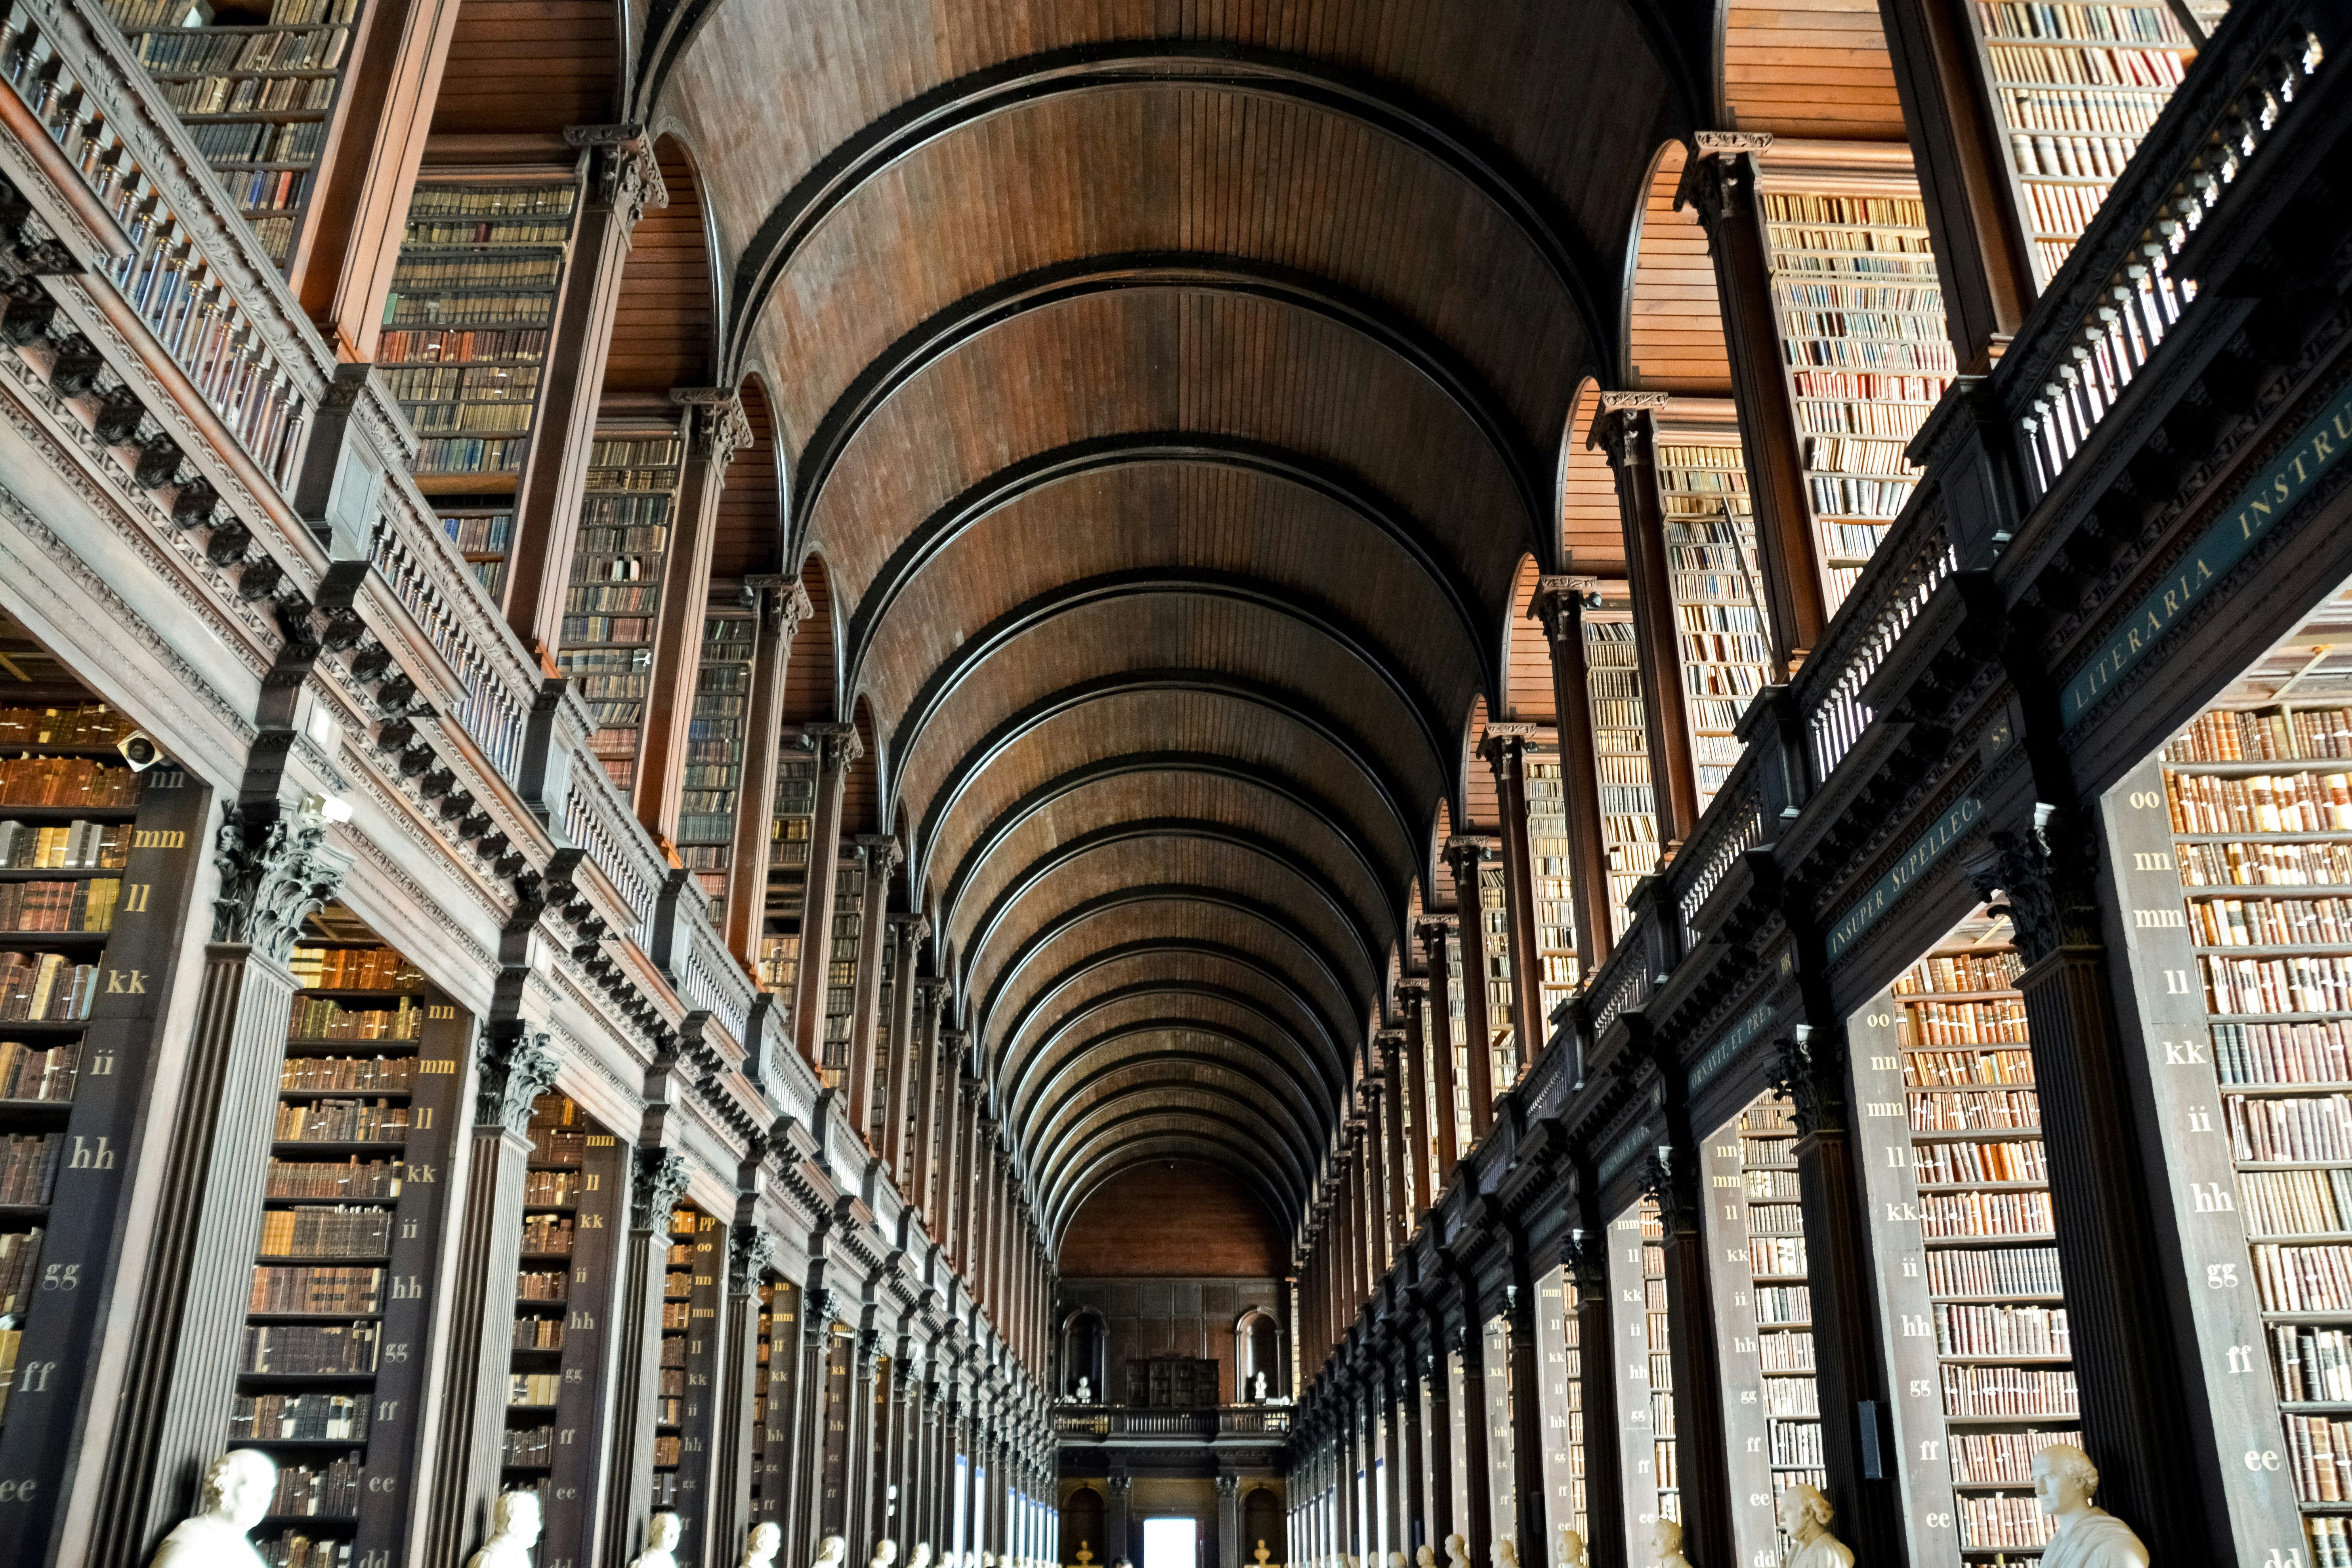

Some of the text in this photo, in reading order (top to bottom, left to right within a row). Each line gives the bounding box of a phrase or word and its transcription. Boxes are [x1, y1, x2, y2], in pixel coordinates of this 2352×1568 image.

[2075, 401, 2352, 710] LITERARIA INSTRU
[1992, 716, 2010, 750] SS
[149, 769, 184, 788] nn
[2130, 792, 2159, 809] oo
[134, 830, 185, 848] mm
[2133, 853, 2173, 870] nn
[124, 884, 149, 912] ll
[1833, 890, 1884, 954] INSUPER
[2133, 909, 2185, 927] mm
[1780, 952, 1791, 975] RR
[105, 970, 150, 994] kk
[2164, 970, 2190, 994] ll
[429, 1005, 454, 1019] nn
[1867, 1014, 1889, 1027] oo
[1731, 1028, 1742, 1051] ET
[2163, 1041, 2207, 1064] kk
[90, 1049, 114, 1074] ii
[419, 1060, 455, 1074] mm
[1871, 1056, 1898, 1070] nn
[1867, 1103, 1905, 1117] mm
[415, 1108, 433, 1129] ll
[2188, 1106, 2213, 1132] ii
[586, 1135, 615, 1146] mm
[68, 1136, 114, 1169] hh
[1717, 1146, 1737, 1157] nn
[1886, 1147, 1905, 1167] ll
[407, 1165, 437, 1183] kk
[586, 1174, 599, 1190] ll
[1713, 1176, 1741, 1187] mm
[2190, 1183, 2235, 1213] hh
[1725, 1205, 1737, 1220] ll
[1886, 1203, 1918, 1221] kk
[581, 1214, 603, 1228] kk
[700, 1217, 715, 1231] pp
[1617, 1219, 1640, 1230] mm
[402, 1219, 417, 1238] ii
[697, 1244, 711, 1252] oo
[1628, 1249, 1639, 1263] ll
[1727, 1249, 1748, 1262] kk
[1902, 1257, 1919, 1278] ii
[42, 1263, 80, 1291] gg
[576, 1268, 586, 1283] ii
[695, 1276, 711, 1285] nn
[2207, 1263, 2238, 1289] gg
[391, 1276, 421, 1299] hh
[1623, 1289, 1642, 1301] kk
[1735, 1292, 1746, 1306] ii
[570, 1312, 594, 1329] hh
[693, 1309, 714, 1318] mm
[1551, 1320, 1560, 1330] ll
[1630, 1323, 1641, 1336] ii
[1901, 1314, 1932, 1336] hh
[691, 1341, 701, 1354] ll
[774, 1341, 783, 1352] ll
[1494, 1339, 1501, 1349] ll
[1734, 1337, 1756, 1353] hh
[385, 1344, 408, 1363] gg
[1549, 1353, 1565, 1362] kk
[2226, 1345, 2253, 1373] ff
[19, 1361, 57, 1392] ff
[565, 1369, 582, 1383] gg
[772, 1371, 788, 1381] kk
[832, 1366, 846, 1375] kk
[1491, 1368, 1504, 1376] kk
[1630, 1365, 1648, 1379] hh
[689, 1374, 706, 1385] kk
[1910, 1379, 1931, 1397] gg
[769, 1399, 778, 1410] ii
[832, 1393, 839, 1402] ii
[1496, 1397, 1502, 1406] ii
[1741, 1391, 1757, 1404] gg
[378, 1401, 397, 1421] ff
[688, 1405, 697, 1416] ii
[1631, 1411, 1645, 1422] gg
[830, 1421, 843, 1431] hh
[1550, 1416, 1565, 1428] hh
[560, 1429, 575, 1445] ff
[768, 1429, 783, 1441] hh
[1495, 1427, 1508, 1437] hh
[684, 1438, 701, 1452] hh
[1747, 1437, 1761, 1452] ff
[1920, 1440, 1939, 1460] ff
[1554, 1454, 1565, 1463] gg
[2244, 1450, 2280, 1471] ee
[1638, 1460, 1650, 1473] ff
[0, 1480, 35, 1502] ee
[369, 1477, 395, 1492] ee
[1558, 1486, 1567, 1497] ff
[556, 1488, 575, 1499] ee
[828, 1489, 836, 1498] ff
[1750, 1494, 1770, 1506] ee
[1639, 1513, 1655, 1524] ee
[1926, 1512, 1950, 1527] ee
[359, 1550, 390, 1568] dd
[1754, 1550, 1776, 1568] dd
